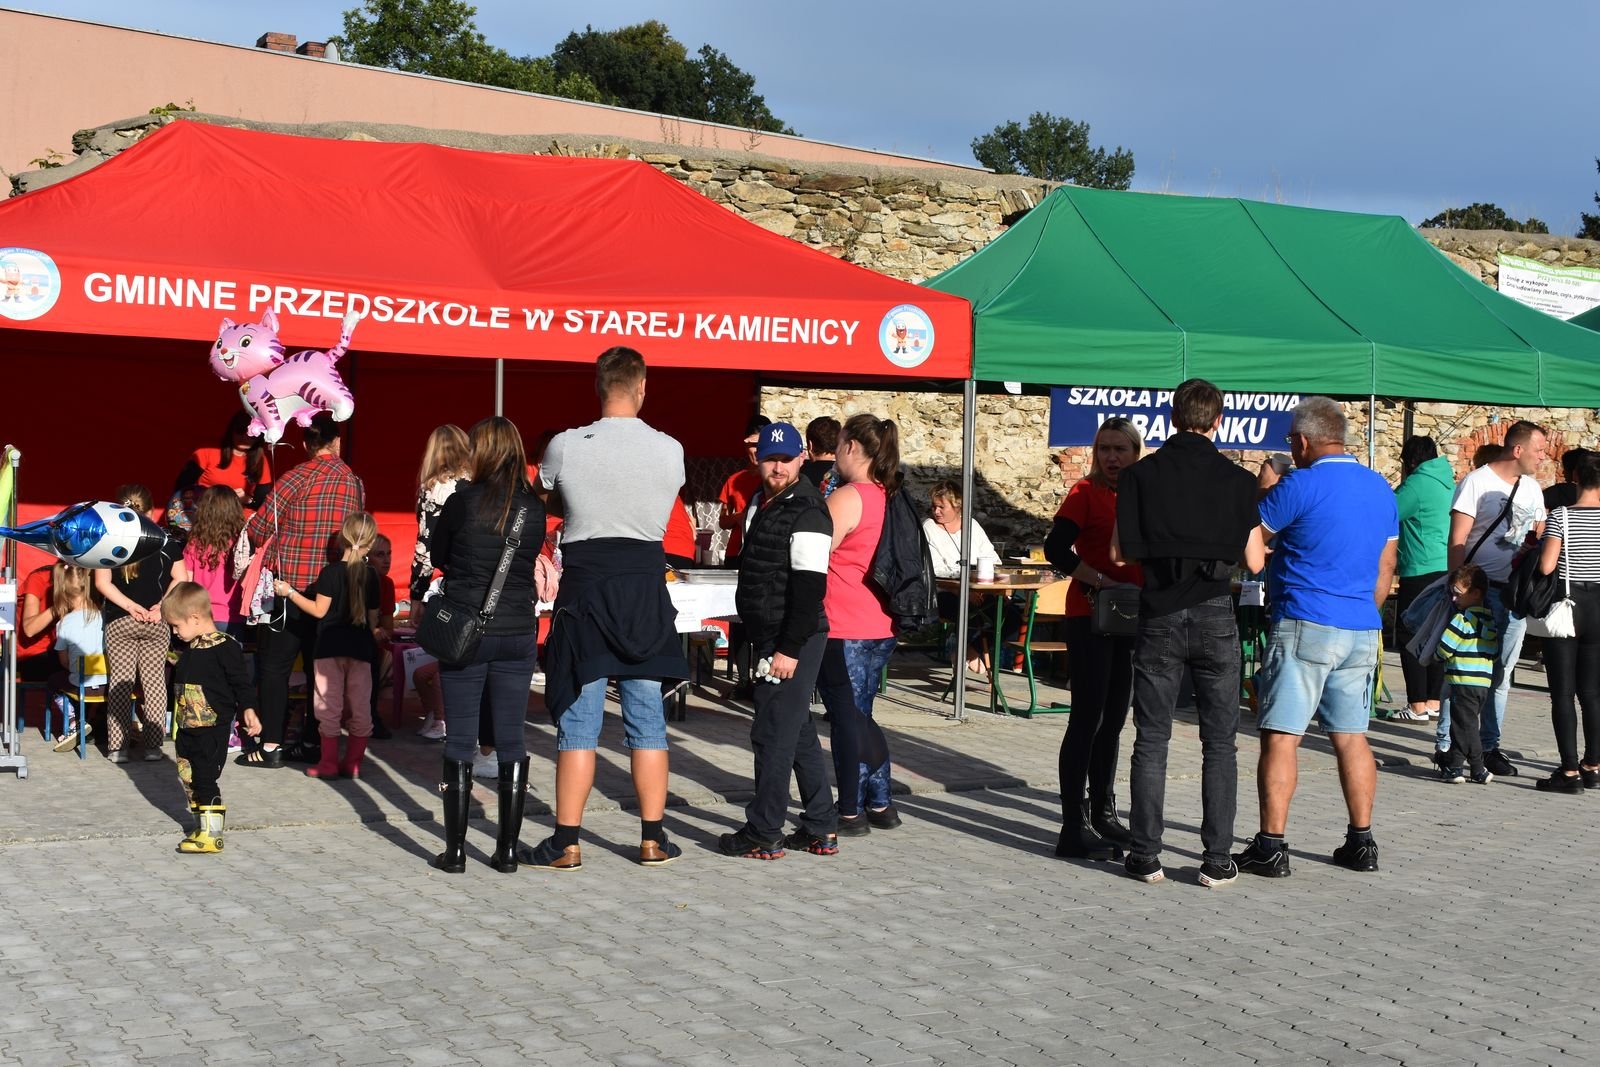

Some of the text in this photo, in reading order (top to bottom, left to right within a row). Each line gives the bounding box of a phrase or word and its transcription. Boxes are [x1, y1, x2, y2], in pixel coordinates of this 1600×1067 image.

[83, 272, 860, 346] GMINNE PRZEDSZKOLE W STAREJ KAMIENICY
[1067, 387, 1300, 412] SZKOŁA PAWOWA
[771, 429, 784, 442] NY
[1132, 413, 1268, 444] BANKU
